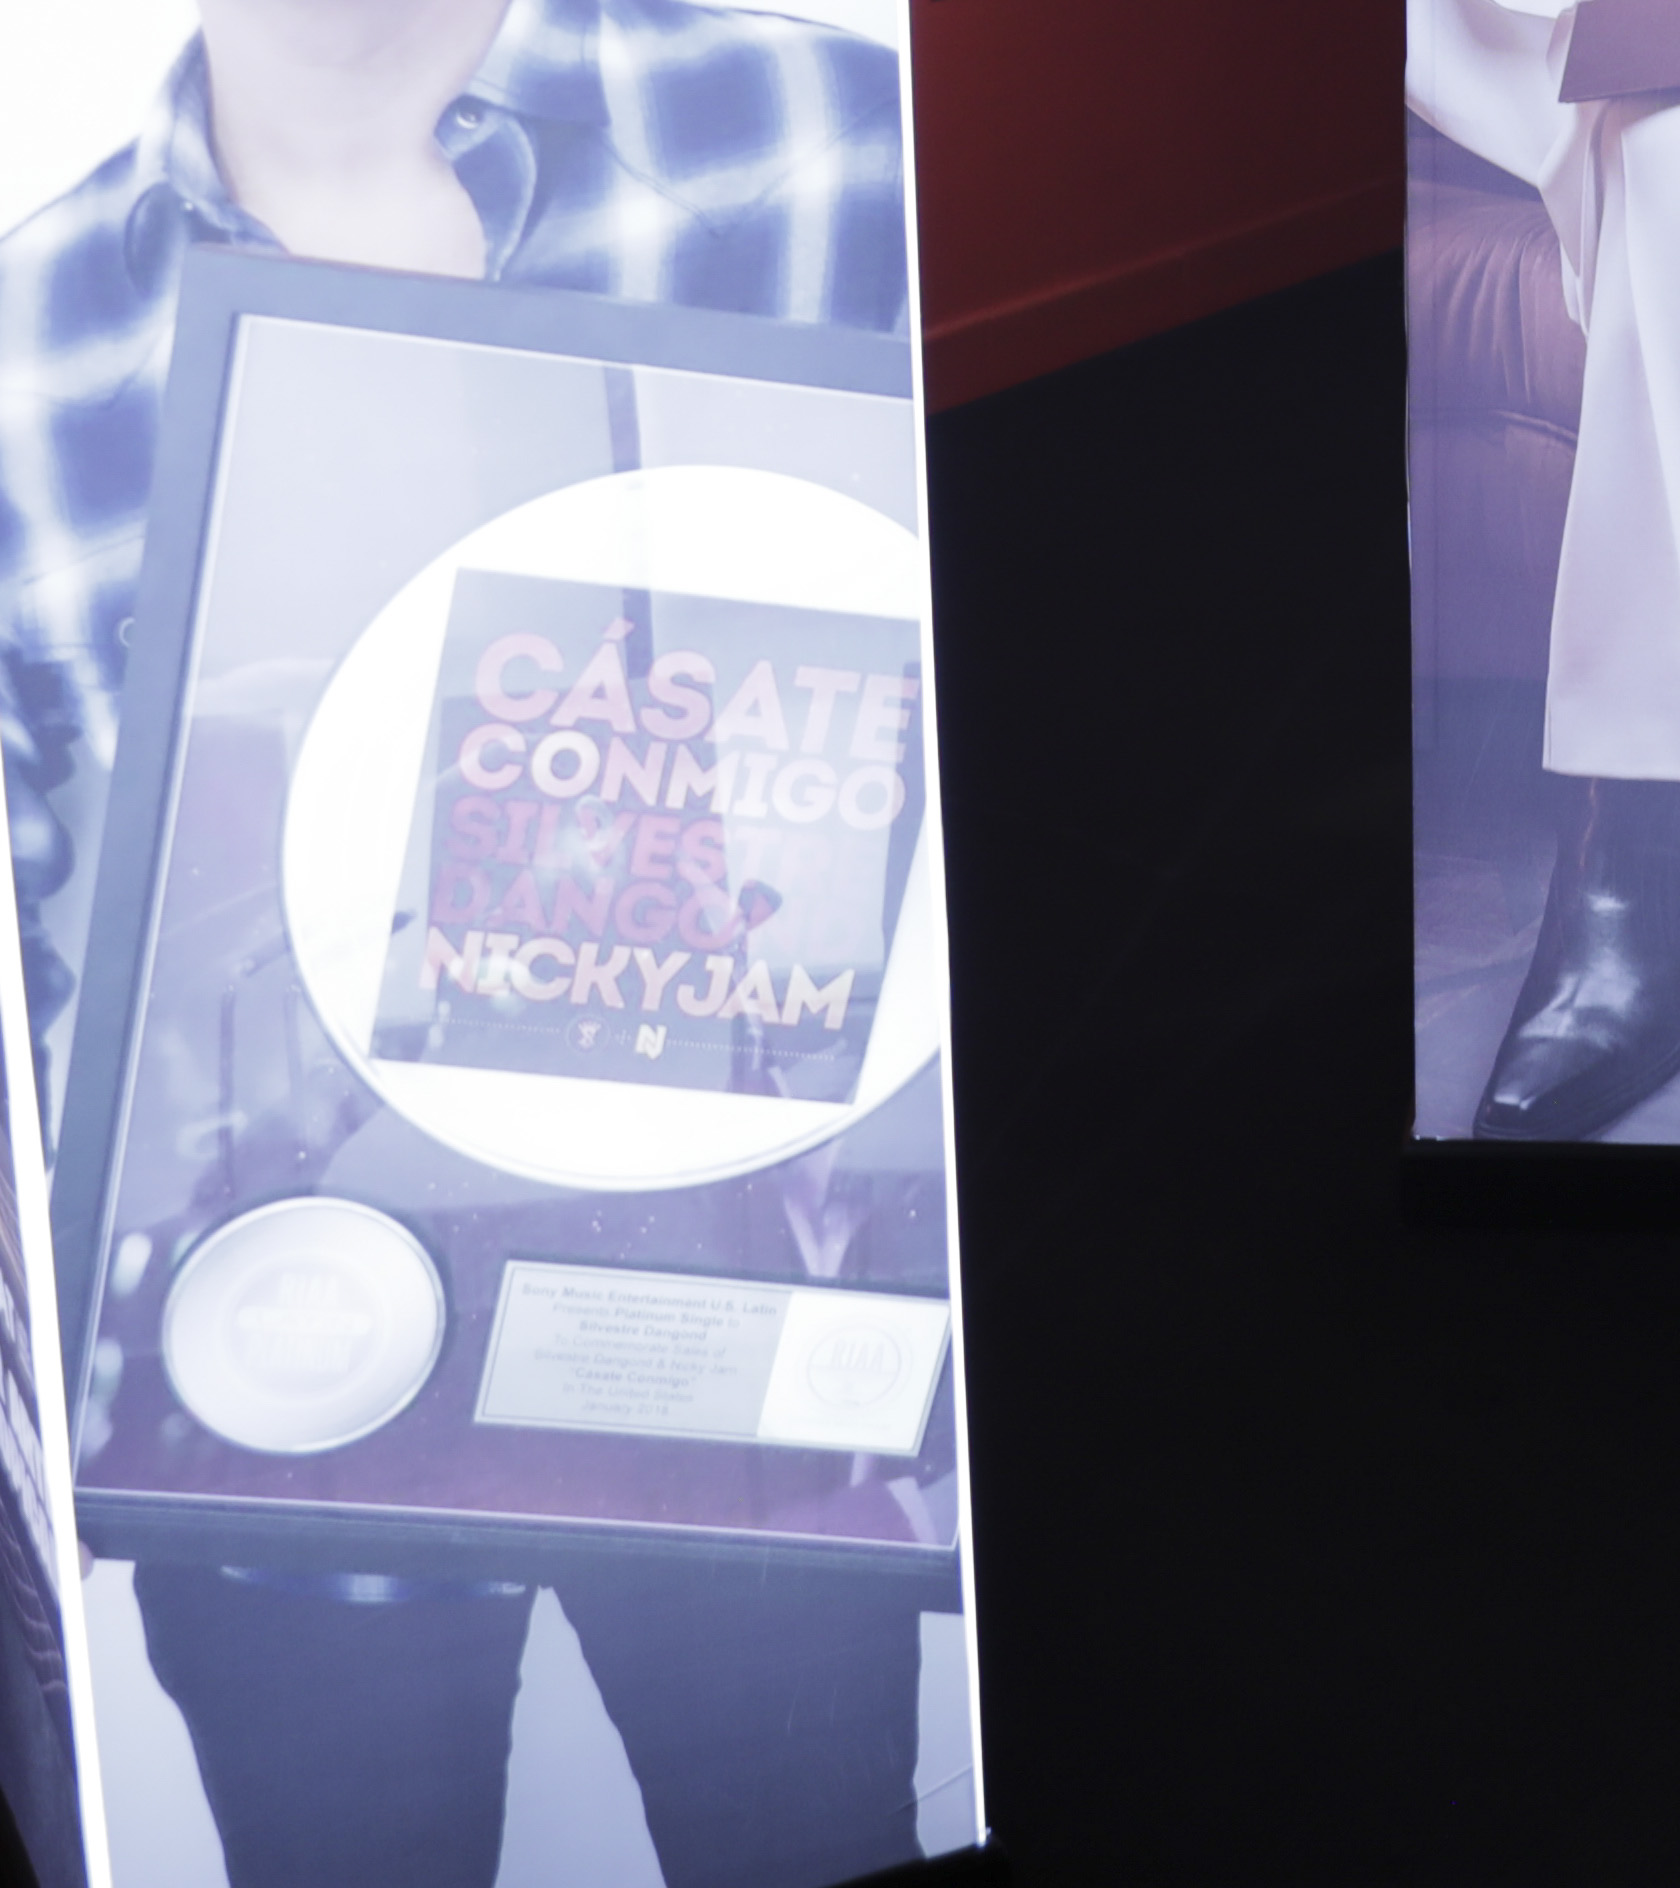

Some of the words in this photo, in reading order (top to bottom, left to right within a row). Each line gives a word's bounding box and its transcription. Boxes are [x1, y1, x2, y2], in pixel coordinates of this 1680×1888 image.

[475, 615, 920, 764] CÁSATE
[459, 722, 906, 830] CONMIGO
[522, 1283, 557, 1299] Sony
[562, 1286, 604, 1301] Music
[743, 1301, 778, 1317] Latin
[615, 1307, 676, 1324] Platinum
[681, 1312, 724, 1329] Single
[579, 1320, 640, 1336] Silvestre
[644, 1324, 707, 1342] Dangond
[573, 1335, 669, 1354] Commemorate
[673, 1342, 708, 1358] Sales
[593, 1352, 653, 1371] Dangond
[579, 1383, 604, 1397] The
[608, 1386, 650, 1401] United
